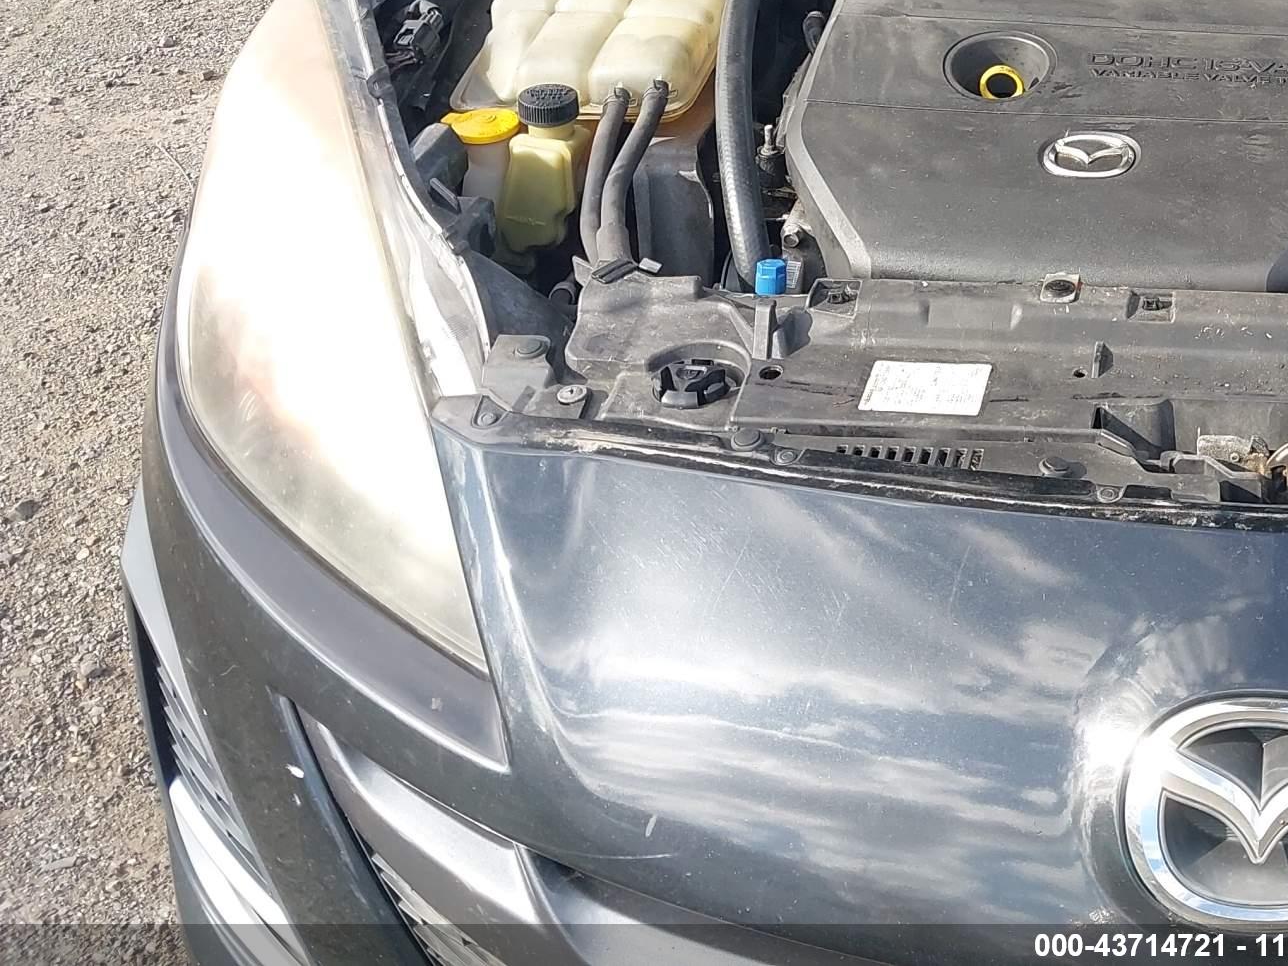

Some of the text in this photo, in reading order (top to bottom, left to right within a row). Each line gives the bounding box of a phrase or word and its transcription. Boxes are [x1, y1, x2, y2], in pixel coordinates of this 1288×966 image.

[1089, 53, 1198, 70] DOHC
[1089, 68, 1200, 81] VARIABLE
[1202, 73, 1271, 84] VALVE
